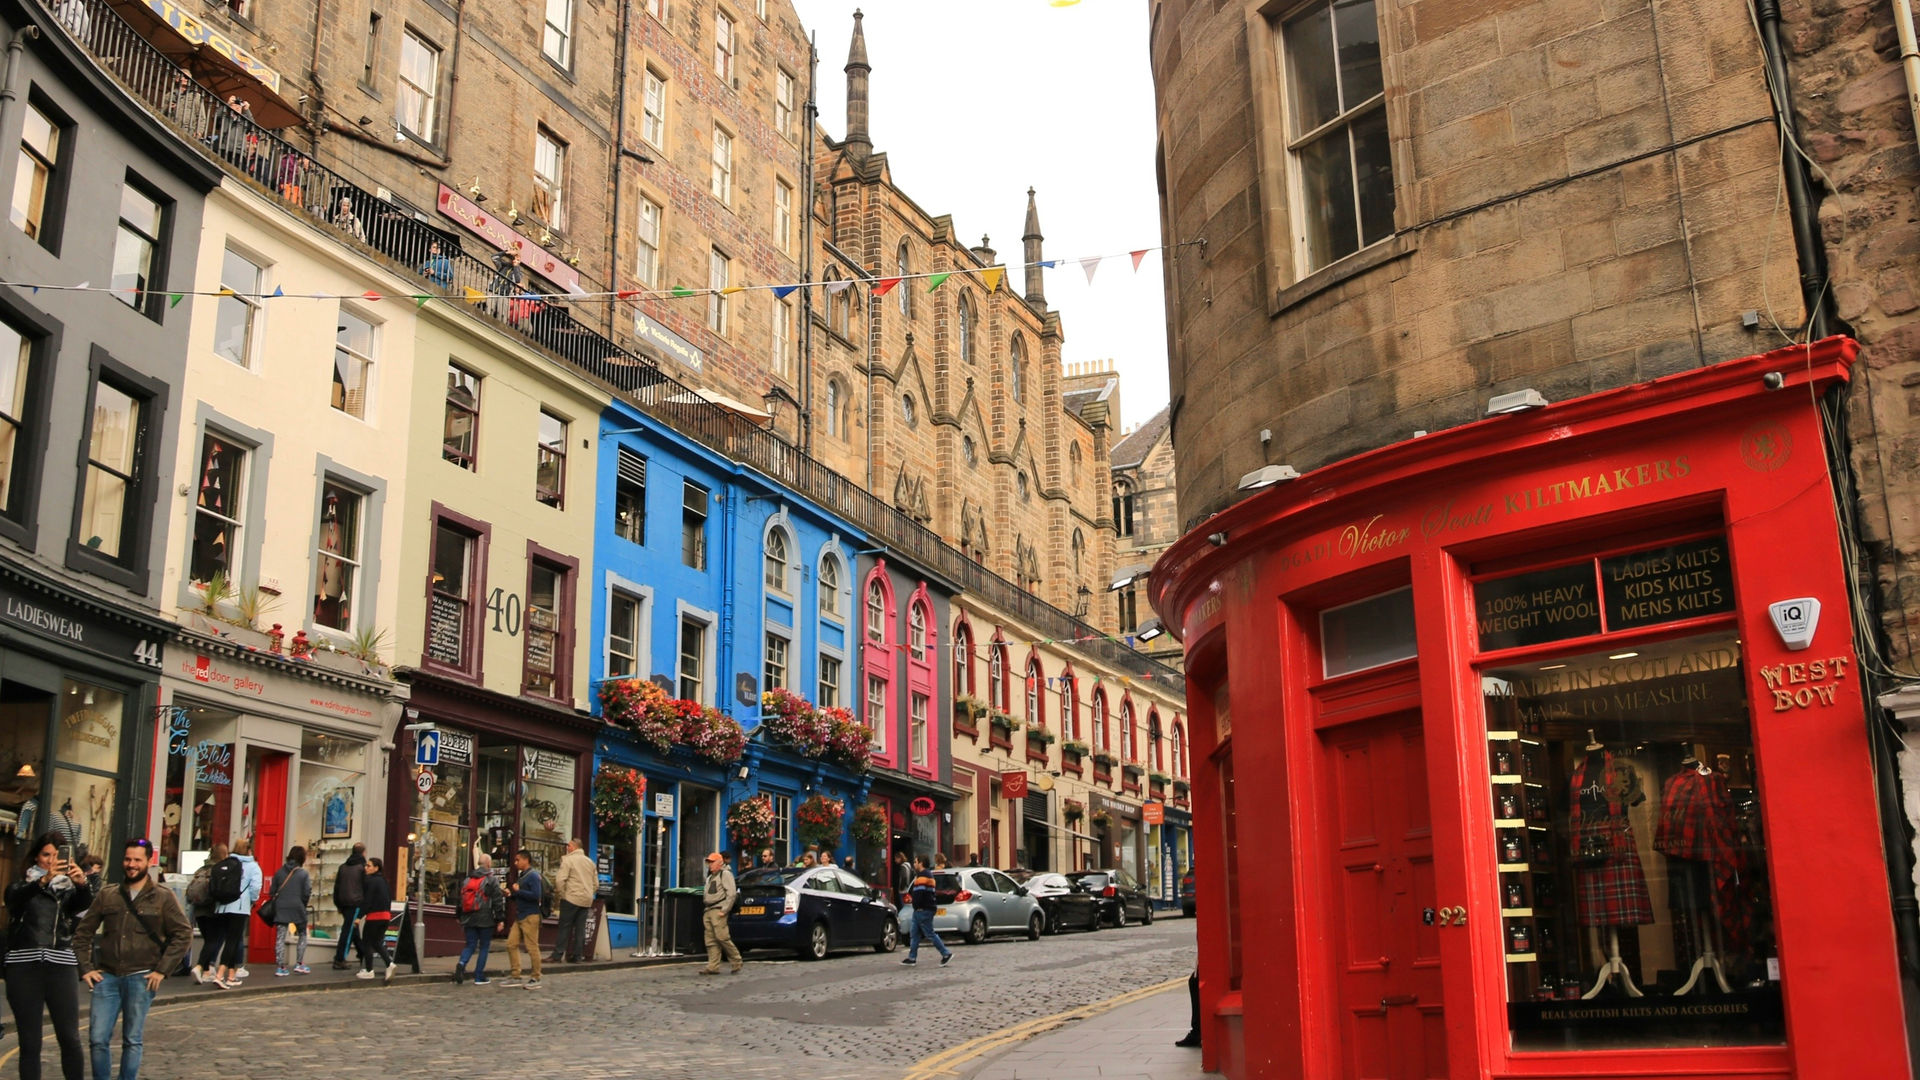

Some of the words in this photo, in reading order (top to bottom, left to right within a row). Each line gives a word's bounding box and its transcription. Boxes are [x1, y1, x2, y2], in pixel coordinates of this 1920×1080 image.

[1338, 513, 1411, 560] Victor
[1420, 500, 1494, 543] Scott
[1503, 454, 1692, 515] KILTMAKERS
[1612, 555, 1671, 582] LADIES
[1675, 547, 1721, 569] KILTS
[1485, 596, 1528, 616] 100%
[1531, 583, 1585, 607] HEAVY
[1624, 578, 1664, 600] KIDS
[1667, 570, 1713, 592] KILTS
[6, 597, 84, 642] LADIESWEAR
[486, 587, 521, 637] 40
[1477, 609, 1541, 636] WEIGHT
[1544, 601, 1598, 624] WOOL
[1620, 597, 1673, 621] MENS
[1676, 588, 1723, 611] KILTS
[1783, 606, 1802, 621] iQ
[182, 660, 196, 675] the
[195, 665, 209, 679] red
[210, 668, 231, 683] door
[233, 675, 264, 695] gallery
[1493, 672, 1563, 702] MADE
[1565, 667, 1594, 691] IN
[1597, 648, 1736, 686] SCOTLAND
[1760, 656, 1849, 690] WEST
[1516, 702, 1570, 724] MADE
[1582, 697, 1609, 717] TO
[1613, 682, 1715, 713] MEASURE
[1772, 681, 1839, 711] BOW
[1439, 905, 1467, 926] 92
[1541, 1009, 1568, 1021] REAL
[1568, 1007, 1620, 1020] SCOTTISH
[1622, 1006, 1651, 1017] KILTS
[1653, 1005, 1678, 1016] AND
[1680, 1003, 1749, 1016] ACCESORIES
